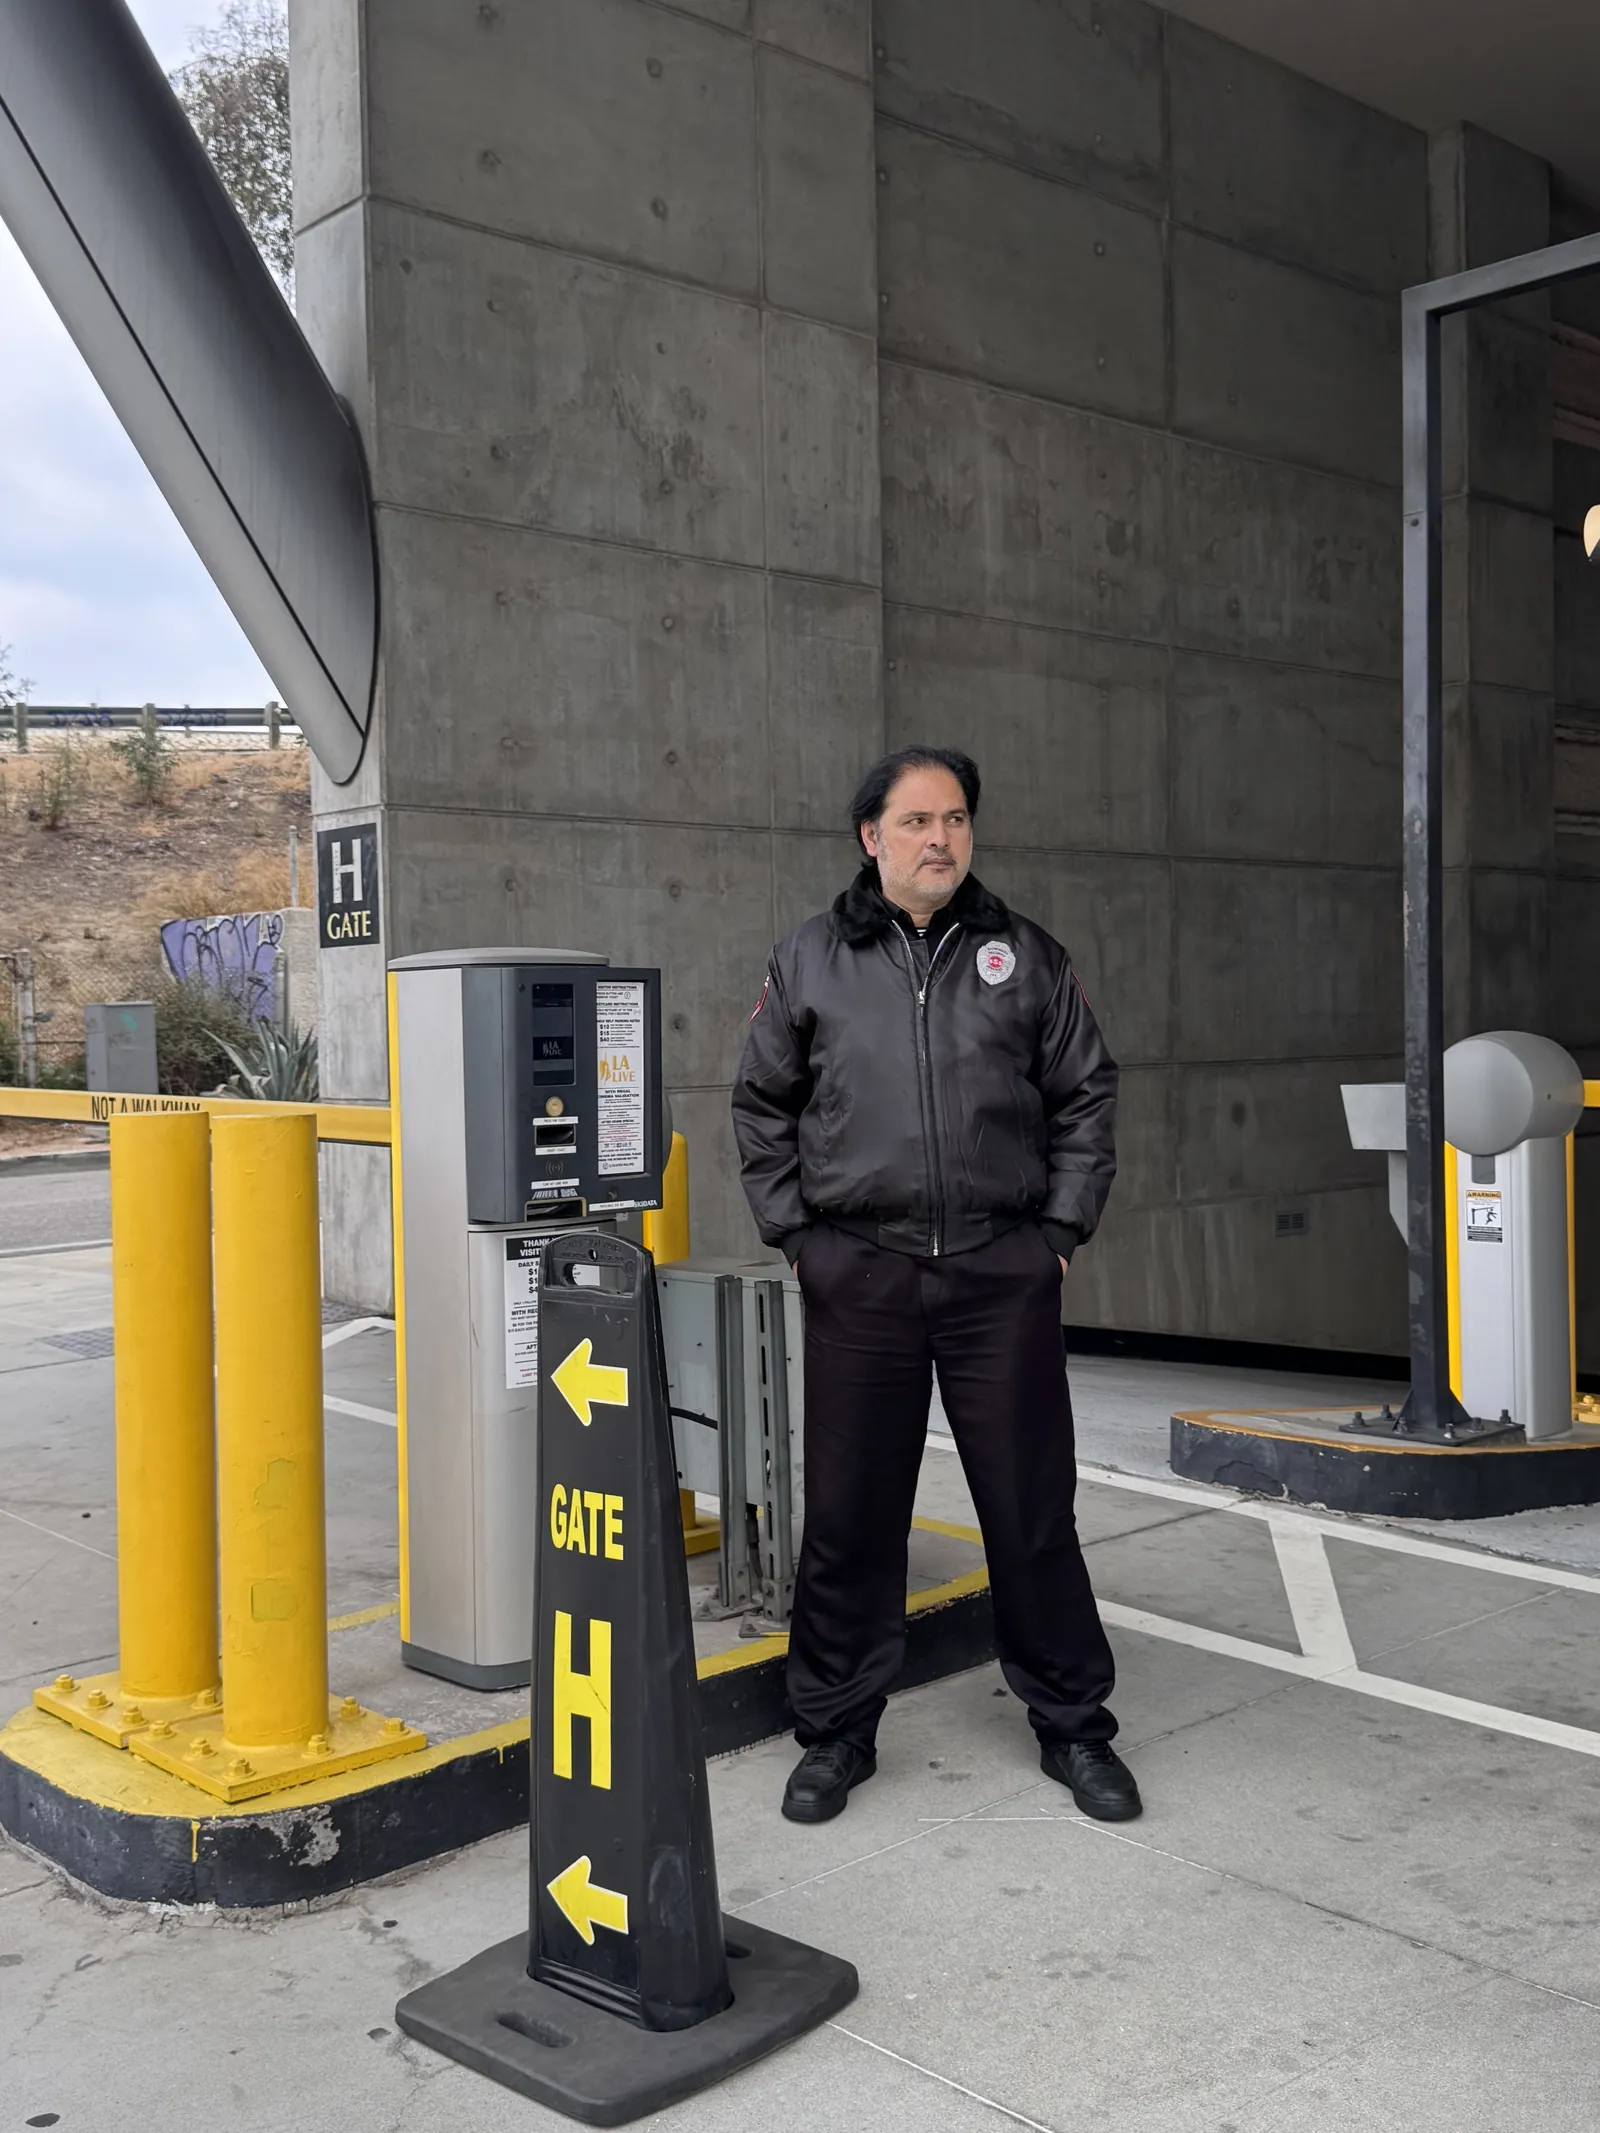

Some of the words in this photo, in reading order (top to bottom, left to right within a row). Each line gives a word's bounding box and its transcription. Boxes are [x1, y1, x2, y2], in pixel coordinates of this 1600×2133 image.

[331, 838, 363, 904] H
[326, 910, 372, 940] GATE
[612, 1055, 629, 1070] LA
[612, 1071, 635, 1082] LIVE
[91, 1096, 116, 1120] NOT
[121, 1098, 128, 1113] A
[523, 1238, 550, 1247] THANK
[550, 1483, 624, 1561] GATE
[553, 1610, 612, 1790] H
